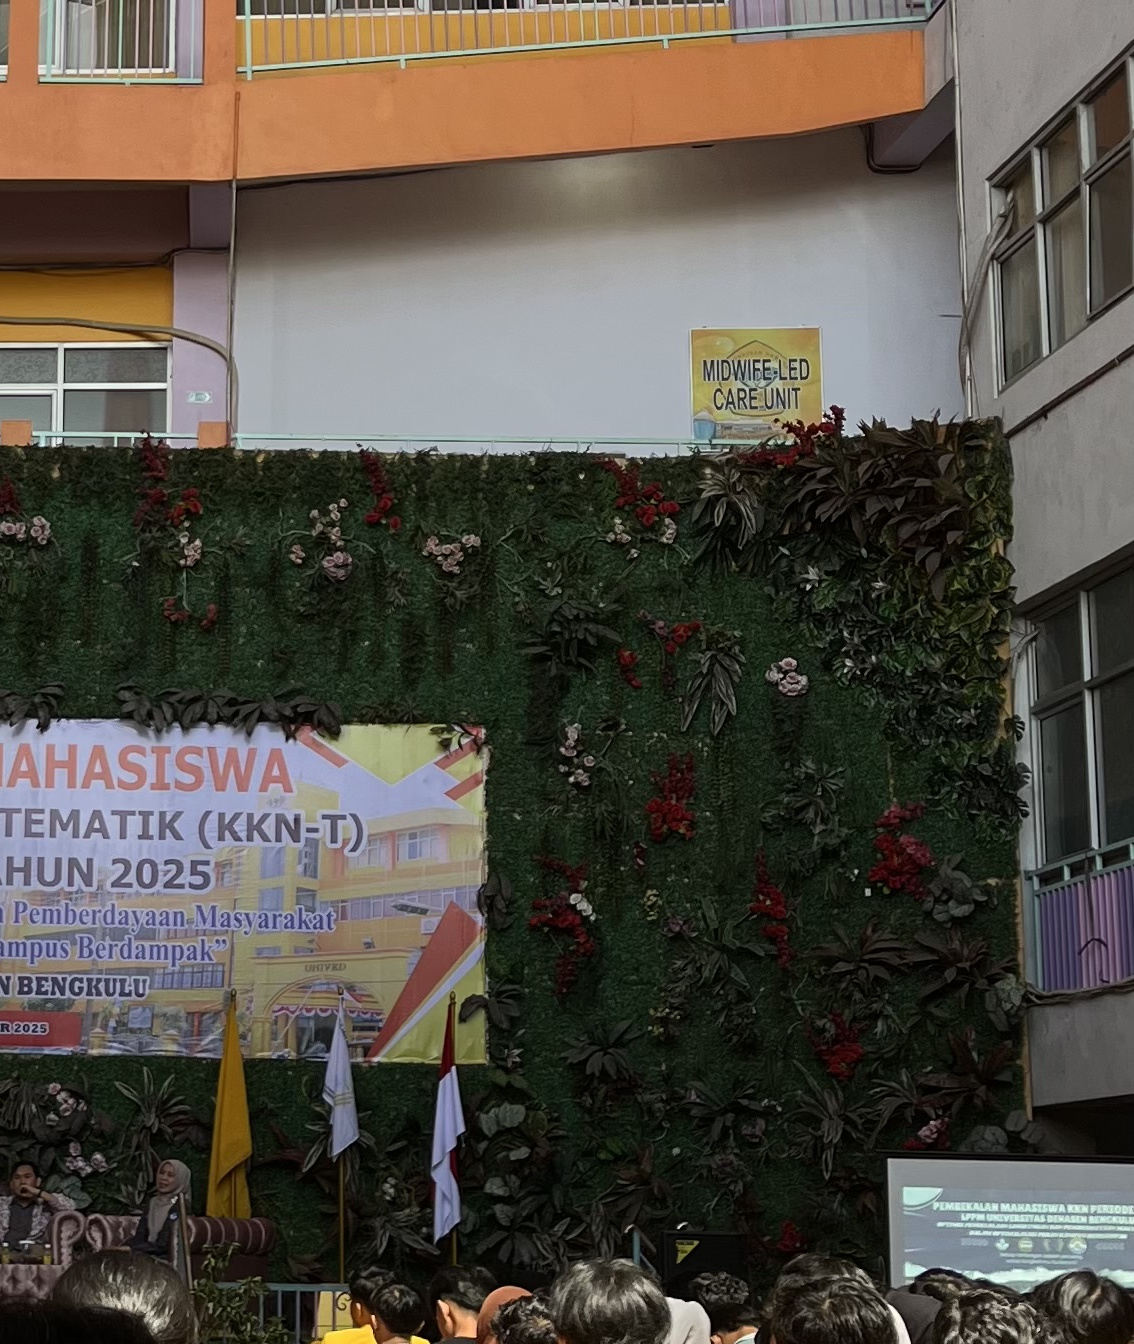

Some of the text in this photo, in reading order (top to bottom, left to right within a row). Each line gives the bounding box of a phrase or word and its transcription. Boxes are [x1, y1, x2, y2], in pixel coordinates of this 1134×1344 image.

[703, 358, 810, 382] MIDWIFE-LED
[713, 387, 801, 411] CARE UNIT
[198, 810, 364, 853] (KKN-T)
[110, 858, 212, 890] 2025
[13, 900, 186, 933] Pemberdayaan
[194, 904, 335, 935] Masyarakat
[78, 935, 228, 968] Berdampak”
[17, 976, 148, 998] BENGKULU
[14, 1023, 48, 1034] 2025
[933, 1201, 999, 1212] PEMBEKALAN
[1000, 1203, 1066, 1213] MAHASISWA
